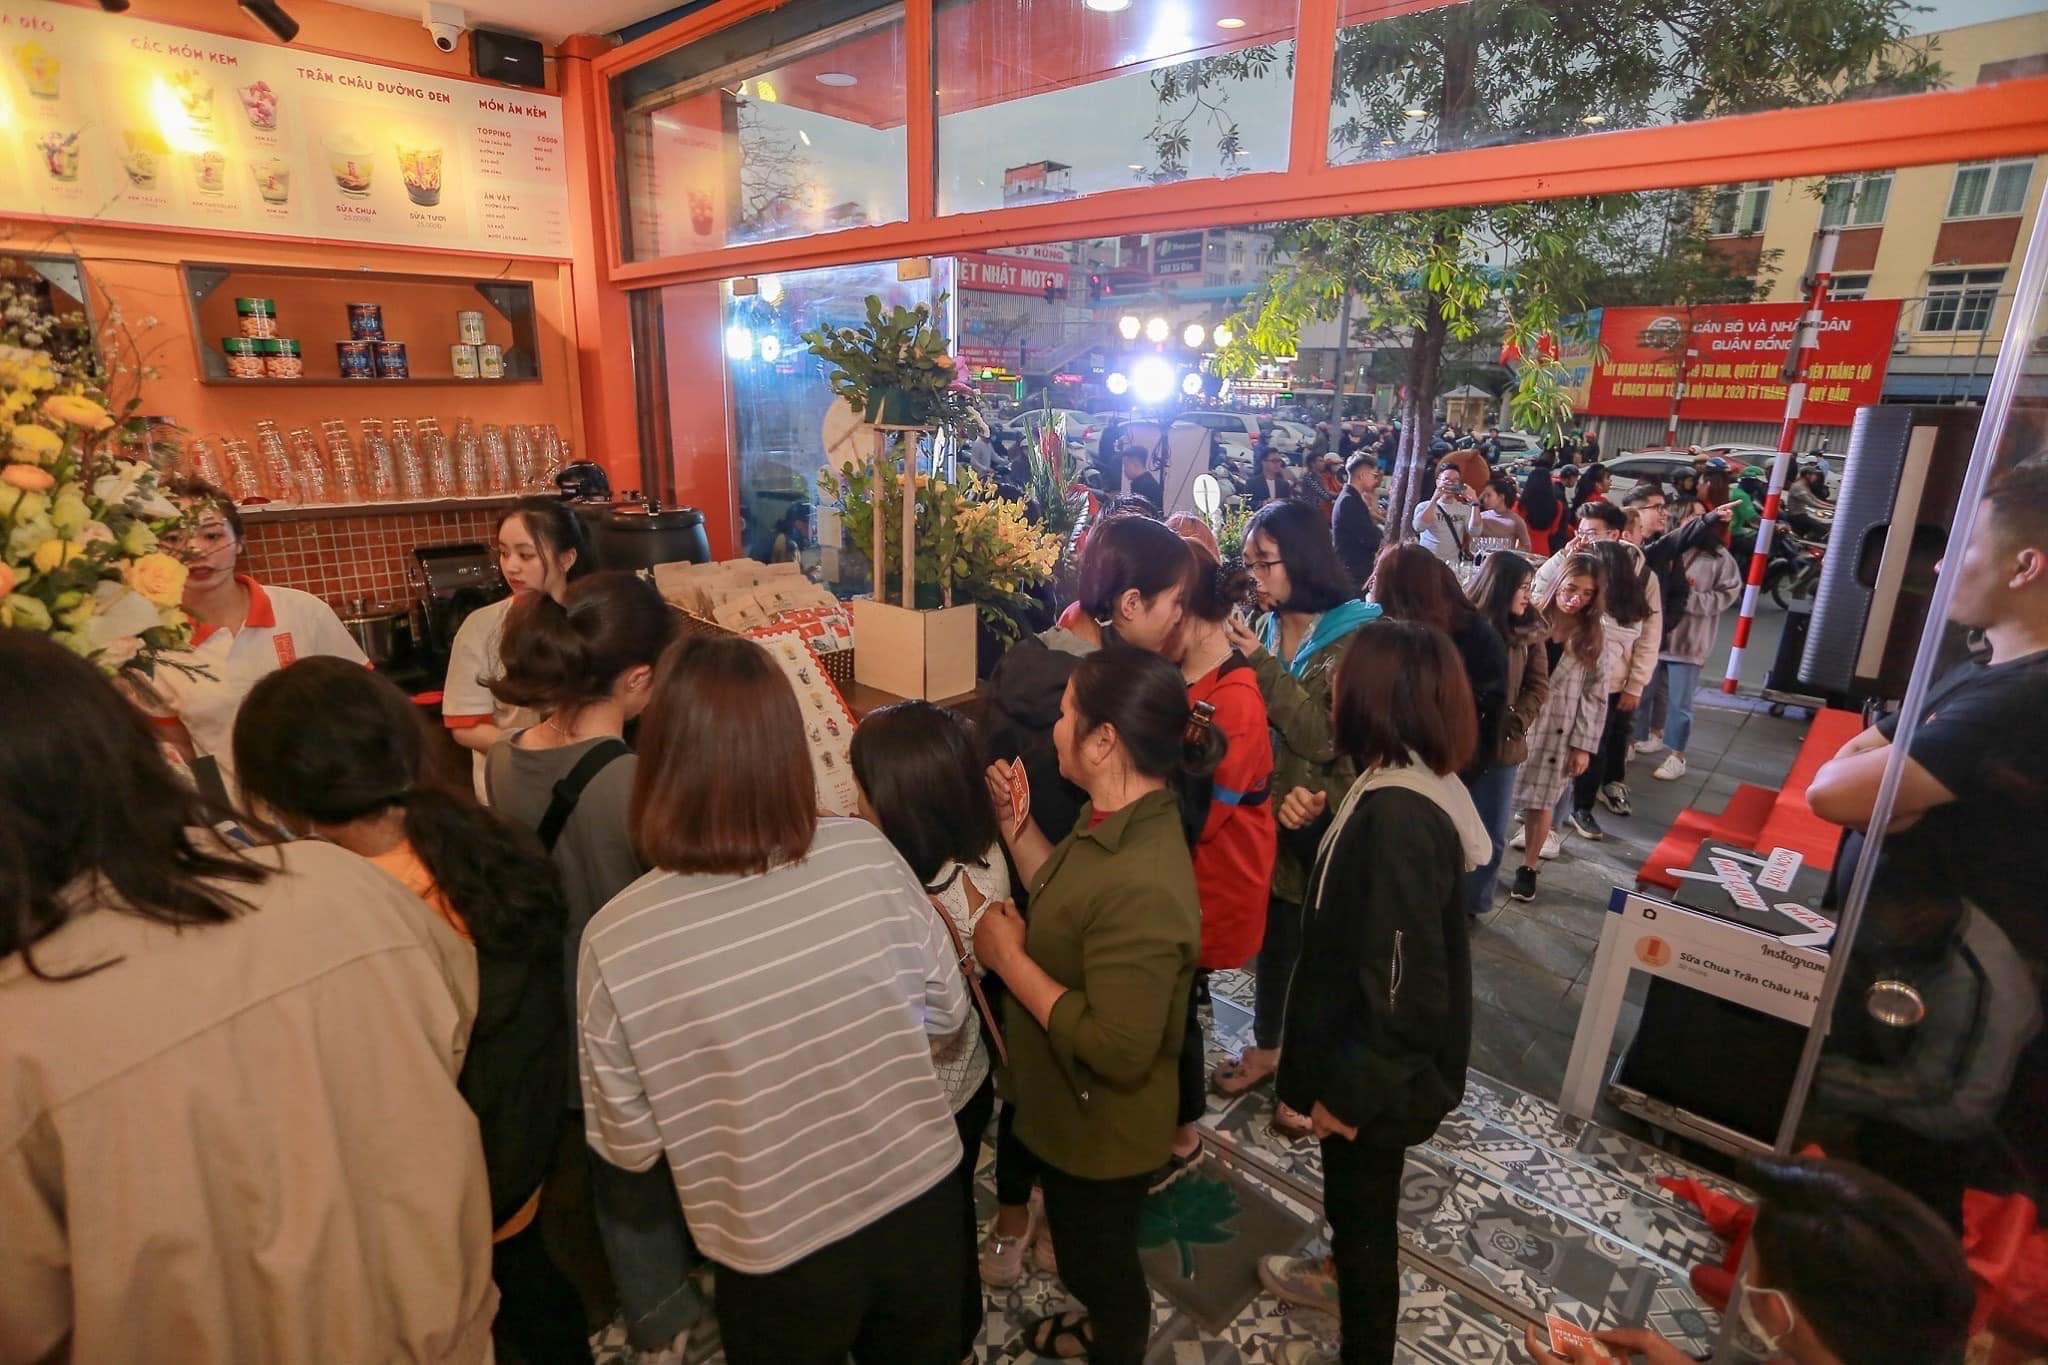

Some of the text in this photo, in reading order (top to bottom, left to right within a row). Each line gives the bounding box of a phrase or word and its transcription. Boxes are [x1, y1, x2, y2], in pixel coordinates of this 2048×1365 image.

[169, 43, 203, 60] MÓN
[210, 53, 238, 66] KEM
[297, 67, 450, 103] TRÂN CHÂU ĐƯỜNG ĐEN
[479, 98, 547, 119] MÓN ĂN KÈM
[477, 127, 511, 138] TOPPING
[355, 207, 377, 215] CHUA
[982, 261, 1017, 289] NHẬT
[1693, 319, 1721, 333] CÁN
[1724, 319, 1745, 336] BỘ
[1748, 318, 1767, 333] VÀ
[1712, 337, 1751, 353] QUẬN
[1825, 361, 1856, 380] THẮNG
[1621, 382, 1646, 398] HOẠCH
[1646, 383, 1665, 397] KINH
[1761, 943, 1826, 973] Instagram
[1679, 951, 1702, 966] Sữa
[1703, 959, 1731, 976] Chua
[1761, 978, 1792, 995] Châu
[1793, 987, 1810, 1001] Hà
